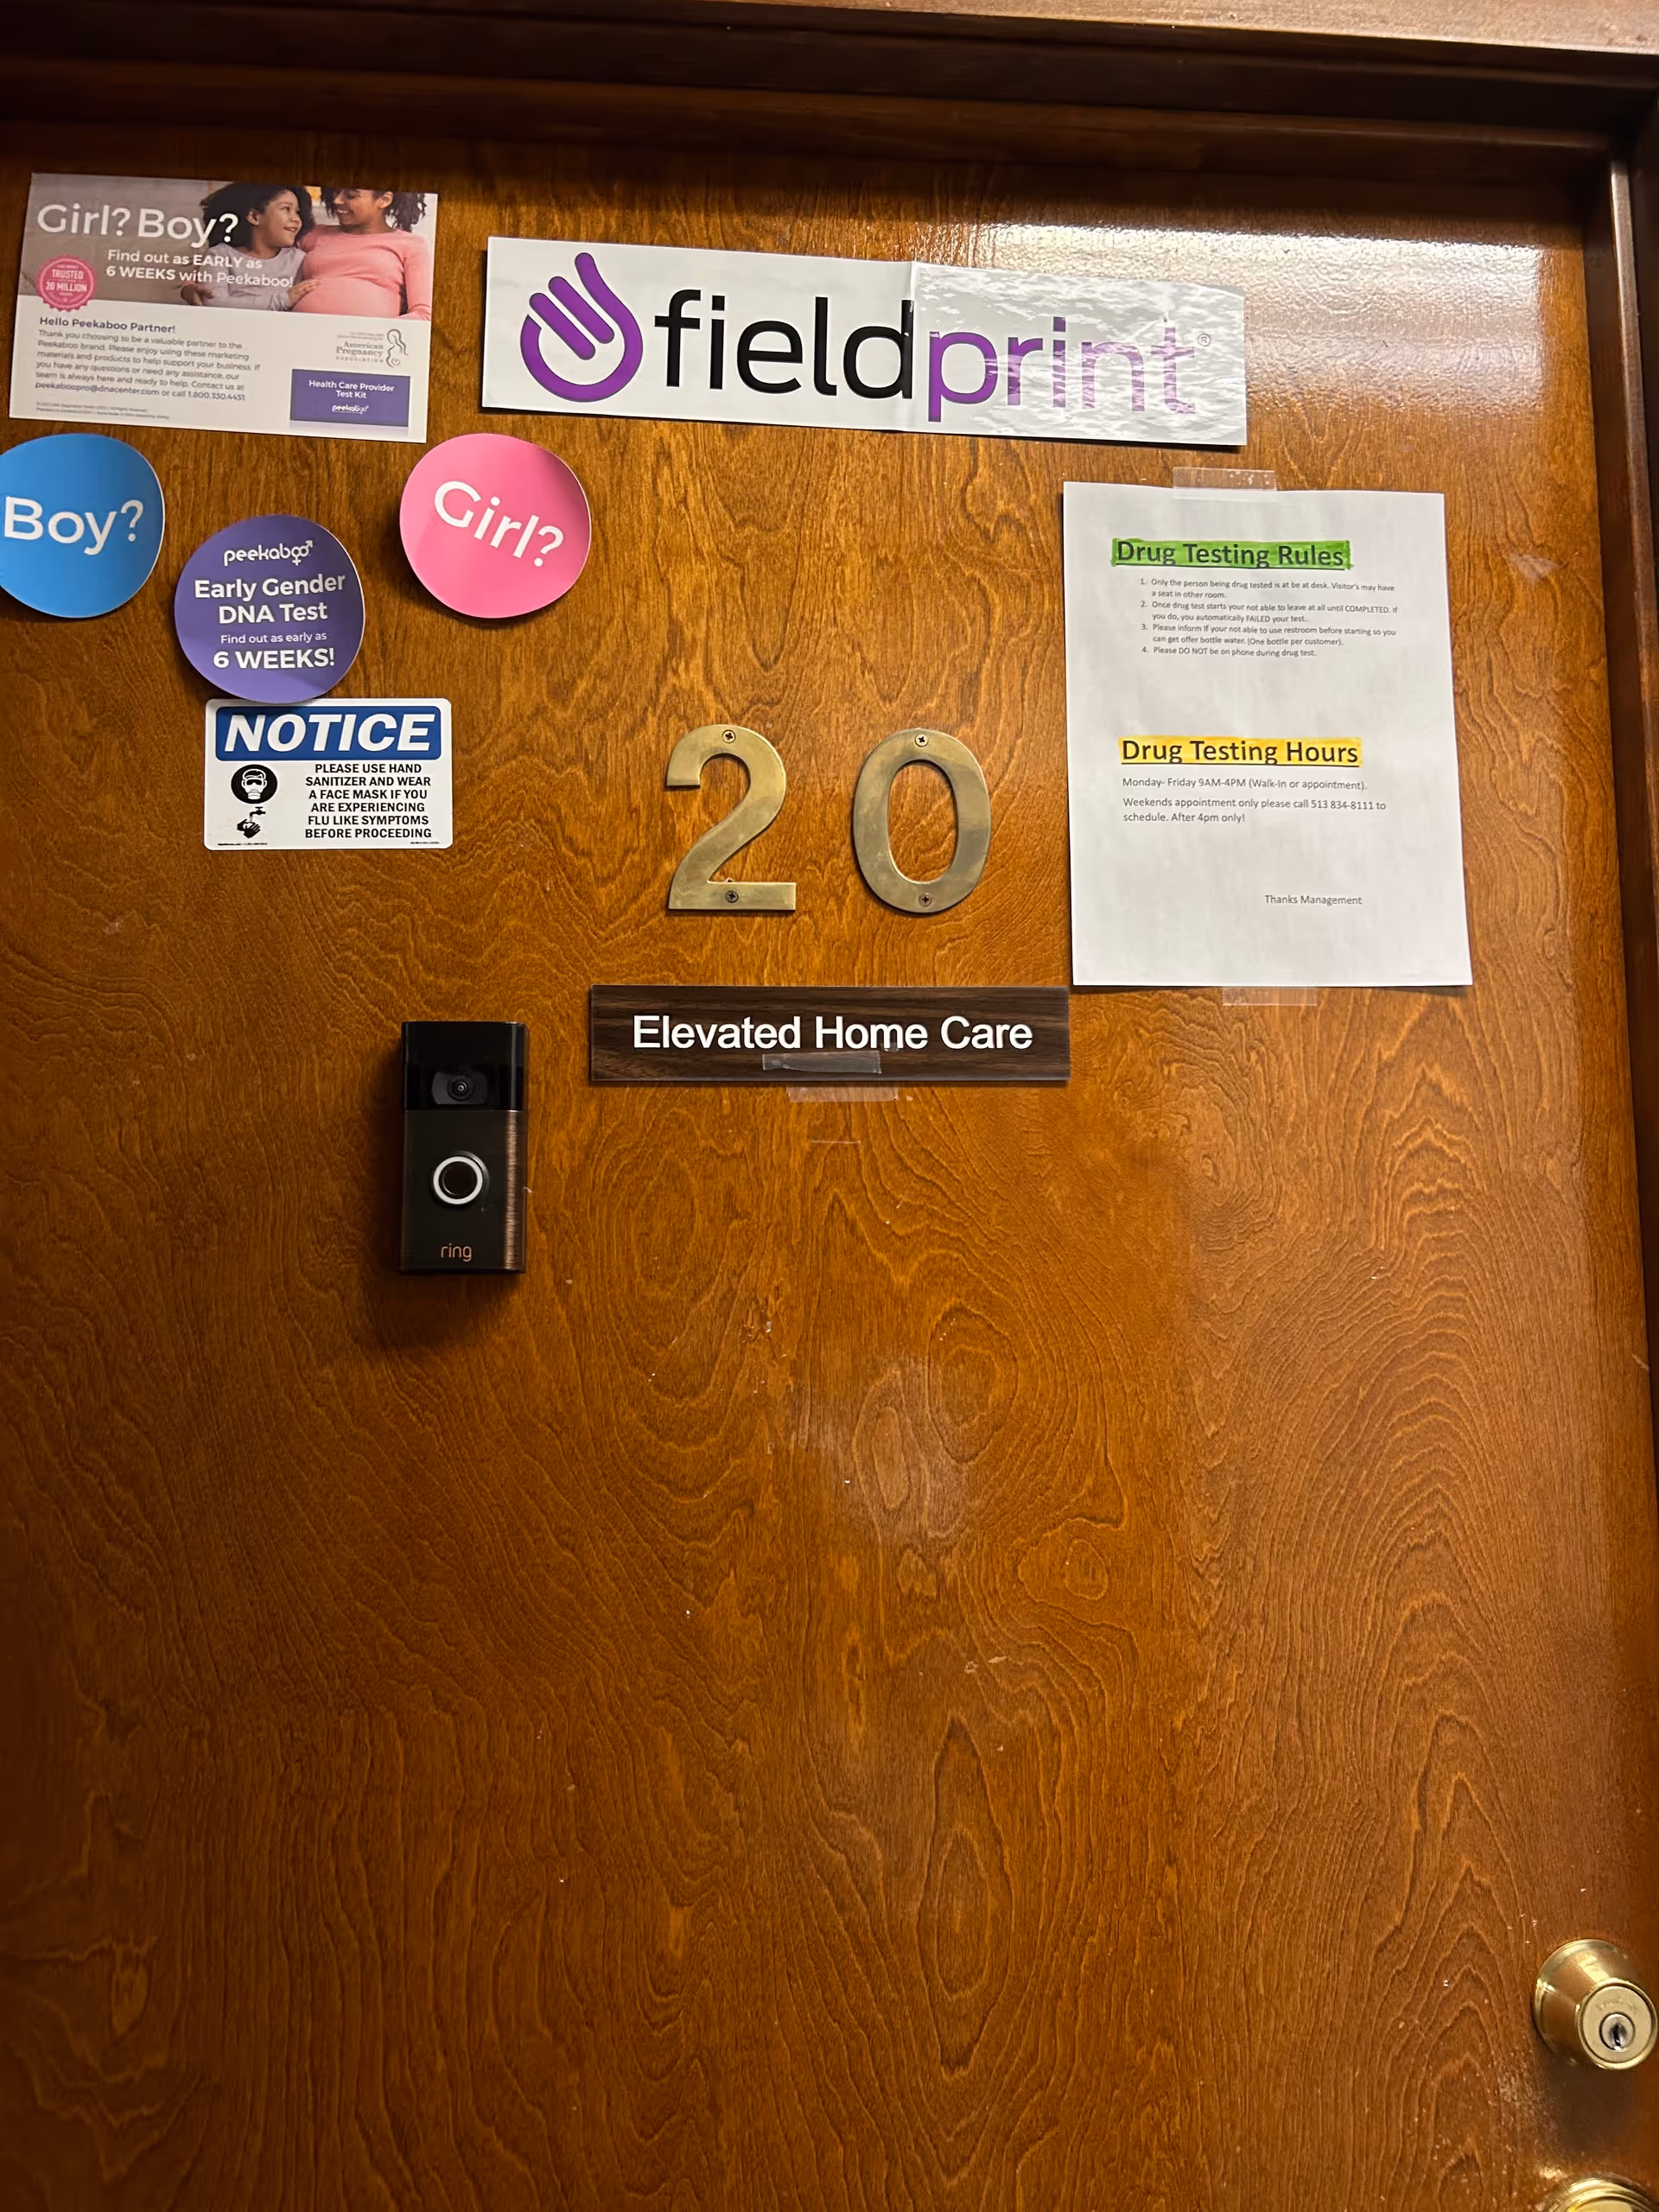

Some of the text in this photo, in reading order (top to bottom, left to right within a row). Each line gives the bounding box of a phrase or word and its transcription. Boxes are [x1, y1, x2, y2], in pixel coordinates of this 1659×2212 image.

[38, 203, 238, 247] Girl? Boy?
[108, 250, 262, 269] Find out as EARLY as
[52, 269, 84, 279] TRUSTED
[106, 266, 293, 288] 6 WEEKS with Peekaboo!
[46, 282, 87, 292] 20 MILLION
[40, 317, 175, 333] Hello Peekaboo Partner!
[343, 341, 384, 349] American
[336, 346, 383, 358] Pregnancy
[654, 289, 1195, 423] fieldprint
[309, 380, 394, 392] Health Care Provider
[4, 496, 143, 555] Boy?
[433, 481, 564, 568] Girl?
[1117, 541, 1344, 568] Drug Testing Rules
[194, 574, 346, 601] Early Gender
[1151, 578, 1169, 587] Only
[1209, 580, 1231, 589] being
[1231, 581, 1248, 589] drug
[1172, 601, 1189, 610] drug
[219, 602, 328, 624] DNA Test
[1195, 614, 1245, 624] automatically
[221, 634, 246, 644] Find
[248, 635, 268, 643] out
[285, 632, 313, 643] early
[1247, 637, 1265, 646] (One
[213, 648, 334, 669] 6 WEEKS!
[1232, 648, 1255, 656] phone
[1256, 649, 1280, 657] during
[1281, 649, 1299, 657] drug
[225, 713, 435, 753] NOTICE
[1123, 740, 1358, 765] Drug Testing Hours
[315, 764, 422, 773] PLEASE USE HAND
[305, 777, 431, 786] SANITIZER AND WEAR
[1123, 777, 1165, 788] Monday-
[1168, 778, 1197, 788] Friday
[1198, 778, 1246, 787] 9AM-4PM
[1302, 780, 1367, 791] appointment).
[308, 789, 427, 799] A FACE MASK IF YOU
[311, 802, 425, 812] ARE EXPERIENCING
[1123, 797, 1172, 807] Weekends
[1175, 798, 1237, 809] appointment
[1238, 798, 1259, 809] only
[1261, 799, 1291, 809] please
[1293, 799, 1309, 808] call
[1311, 800, 1328, 809] 513
[1330, 800, 1374, 810] 834-8111
[308, 815, 429, 825] FLU LIKE SYMPTOMS
[1123, 812, 1245, 824] schedule. After 4pm only!
[305, 828, 432, 838] BEFORE PROCEEDING
[1264, 895, 1363, 906] Thanks Management
[634, 1015, 1033, 1049] Elevated Home Care
[441, 1243, 472, 1262] ring
